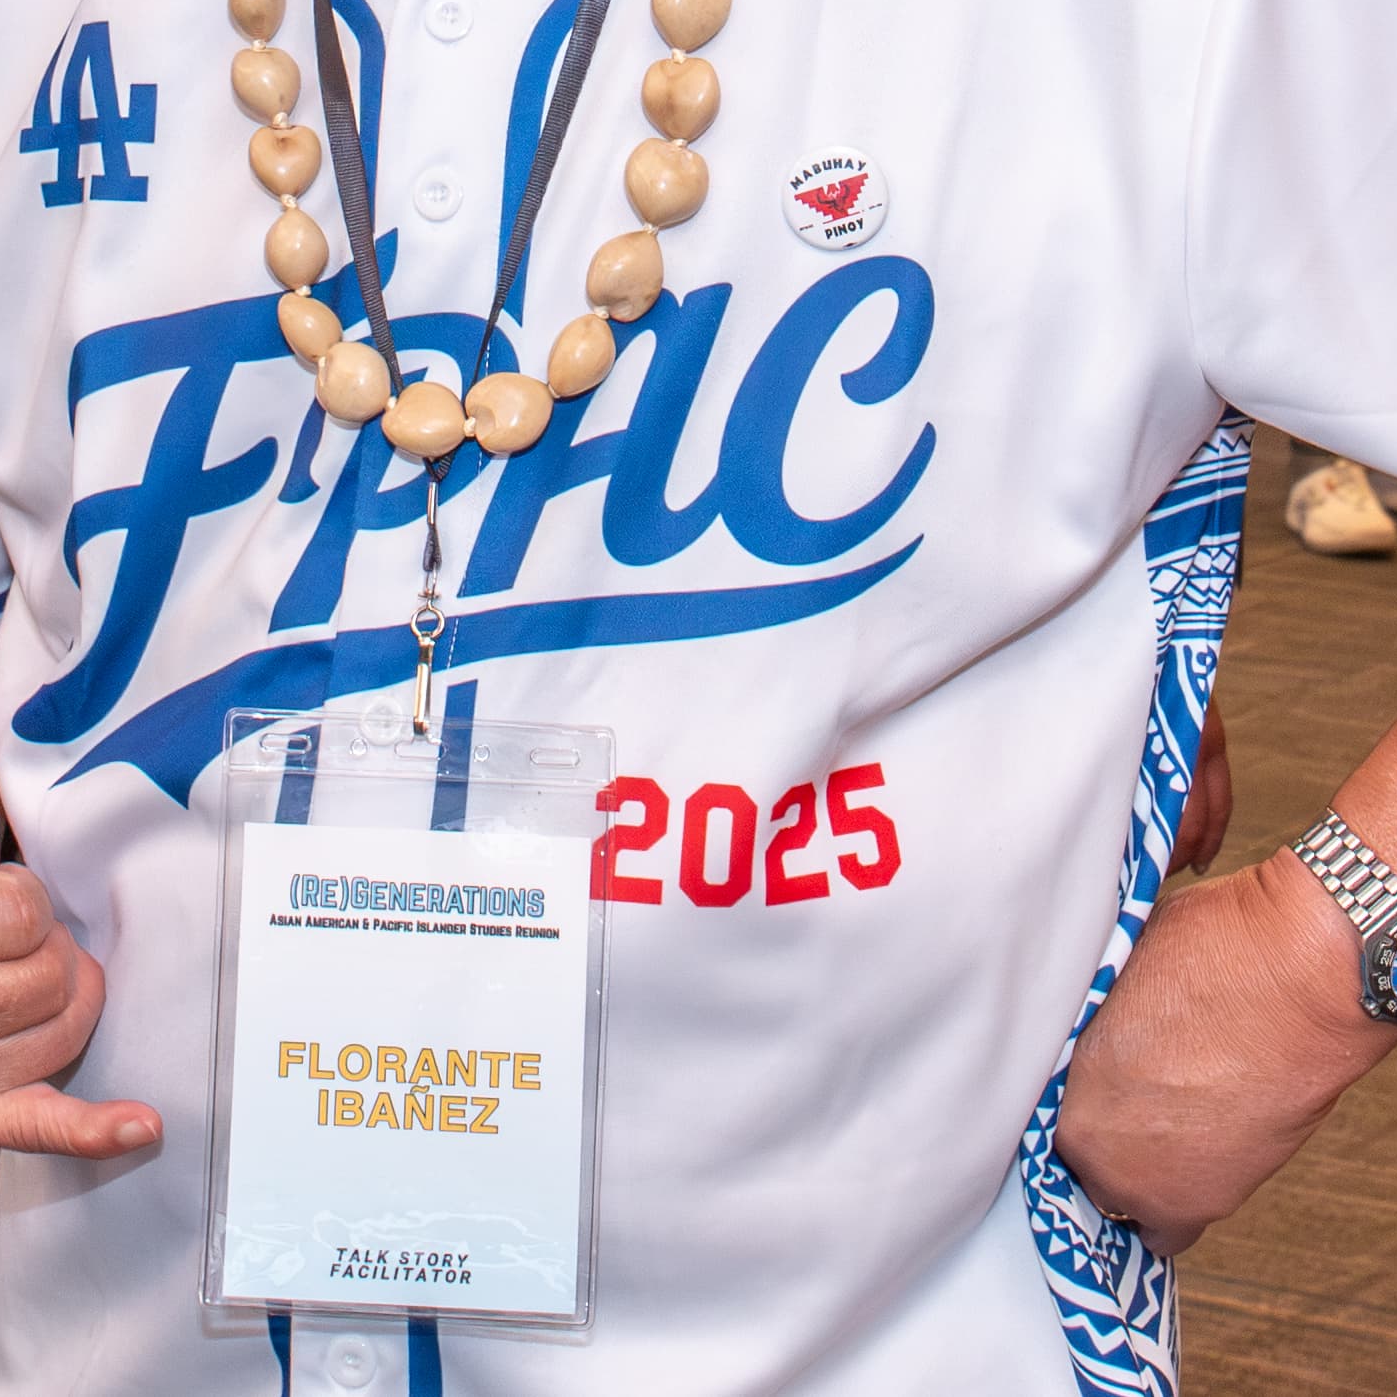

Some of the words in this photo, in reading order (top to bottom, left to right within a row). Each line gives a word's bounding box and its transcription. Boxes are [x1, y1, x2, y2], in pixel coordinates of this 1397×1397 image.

[19, 20, 158, 208] LA
[789, 158, 867, 191] MABUHAY
[824, 217, 864, 240] PINOY
[590, 762, 902, 908] 2025
[269, 913, 302, 927] ASIAN
[305, 915, 359, 930] AMERICAN
[362, 918, 370, 931] &
[373, 918, 413, 933] PACIFIC
[416, 920, 467, 935] ISLANDER
[469, 923, 512, 937] STUDIES
[515, 925, 560, 939] REUNION
[277, 1040, 542, 1091] FLORANTE
[317, 1084, 501, 1135] IBAÑEZ
[329, 1263, 472, 1285] FACILITATOR
[335, 1247, 390, 1265] TALK
[398, 1251, 469, 1269] STORY
